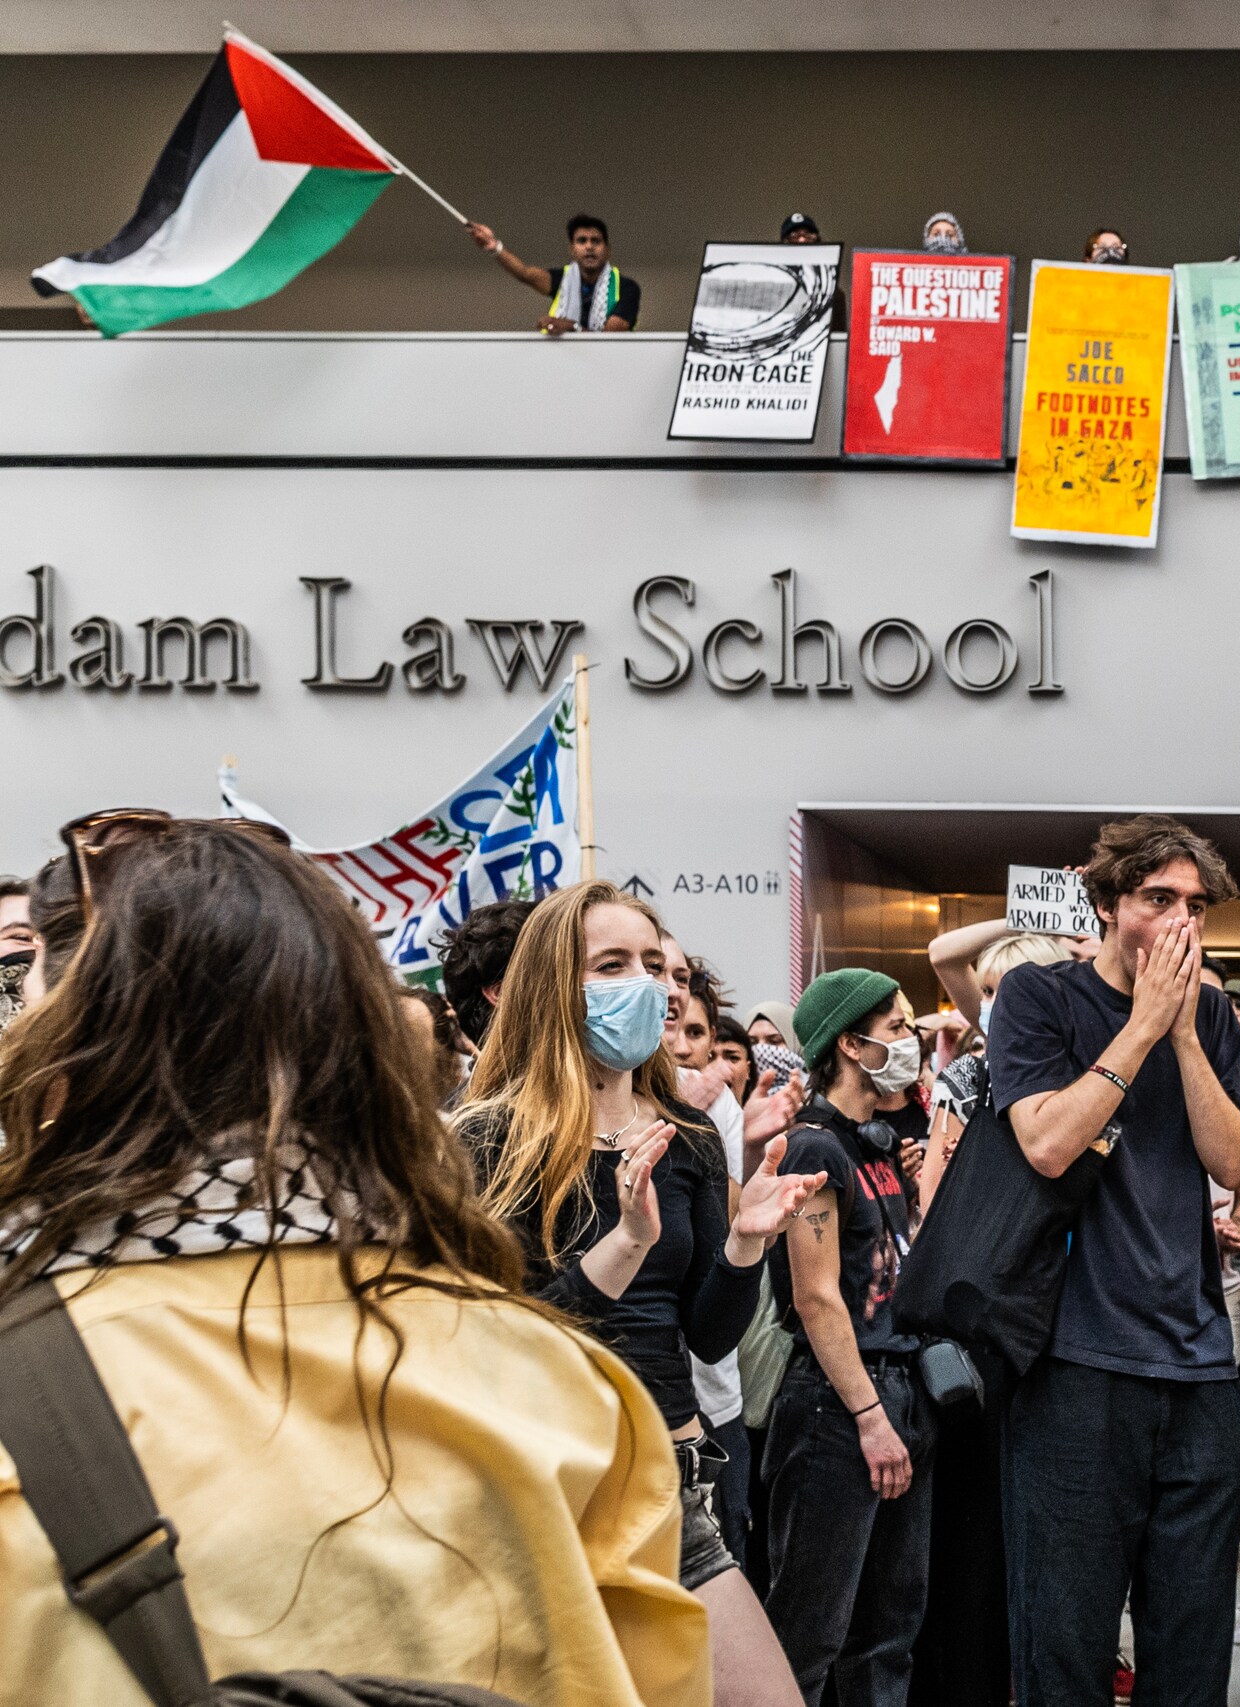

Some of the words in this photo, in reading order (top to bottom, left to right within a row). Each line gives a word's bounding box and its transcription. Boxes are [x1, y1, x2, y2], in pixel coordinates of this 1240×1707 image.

[871, 267, 899, 286] THE
[902, 267, 980, 288] QUESTION
[983, 270, 1003, 289] OF
[871, 285, 1000, 320] PALESTINE
[870, 326, 921, 342] EDWARD
[922, 327, 936, 342] W.
[869, 341, 901, 356] SAID
[1080, 341, 1113, 360] JOE
[687, 363, 744, 382] IRON
[752, 363, 813, 383] CAGE
[1067, 364, 1124, 384] SACCO
[683, 397, 740, 409] RASHID
[746, 398, 807, 410] KHALIDI
[1037, 392, 1150, 417] FOOTNOTES
[1051, 417, 1069, 438] IN
[1080, 419, 1132, 440] GAZA
[0, 564, 260, 692] dam
[299, 577, 586, 692] Law
[624, 568, 1065, 693] School
[312, 818, 462, 924] THE
[1040, 870, 1077, 887] DON'T
[673, 874, 758, 894] A3-A10
[1012, 884, 1065, 903] ARMED
[1007, 909, 1061, 930] ARMED
